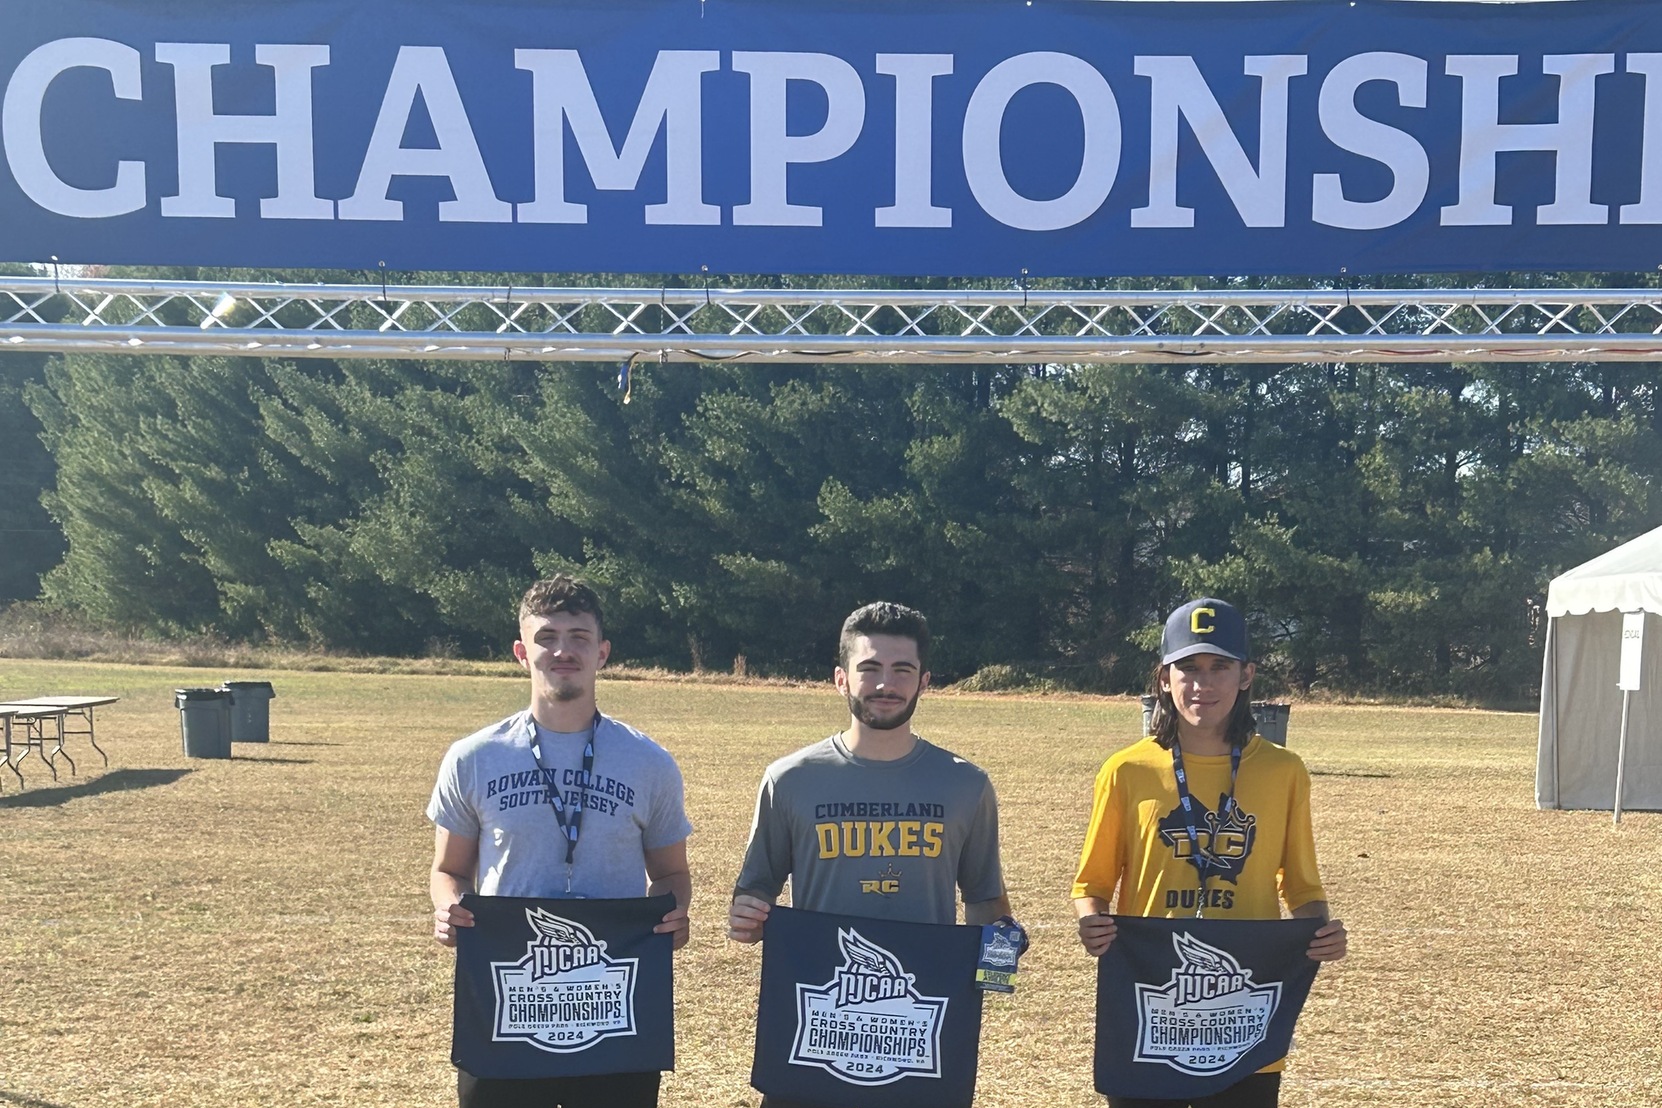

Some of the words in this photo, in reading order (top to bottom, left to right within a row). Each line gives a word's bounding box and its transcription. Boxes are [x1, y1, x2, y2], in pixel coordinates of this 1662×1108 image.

[1190, 607, 1216, 634] C
[486, 768, 557, 799] ROWAN
[563, 768, 635, 807] COLLEGE
[815, 802, 944, 819] CUMBERLAND
[815, 820, 945, 860] DUKES
[859, 880, 900, 898] RC
[533, 945, 600, 981] NJCAA
[509, 993, 554, 1003] CROSS
[559, 991, 622, 1002] COUNTRY
[836, 973, 908, 1007] NJCAA
[1176, 974, 1244, 1007] NJCAA
[509, 1000, 622, 1023] CHAMPIONSHIPS
[1151, 1016, 1196, 1027] CROSS
[1200, 1014, 1265, 1027] COUNTRY
[548, 1030, 584, 1041] 2024
[811, 1018, 856, 1031] CROSS
[861, 1023, 927, 1037] COUNTRY
[1151, 1023, 1263, 1046] CHAMPIONSHIPS
[809, 1028, 926, 1058] CHAMPIONSHIPS
[846, 1061, 884, 1074] 2024
[1189, 1054, 1226, 1065] 2024
